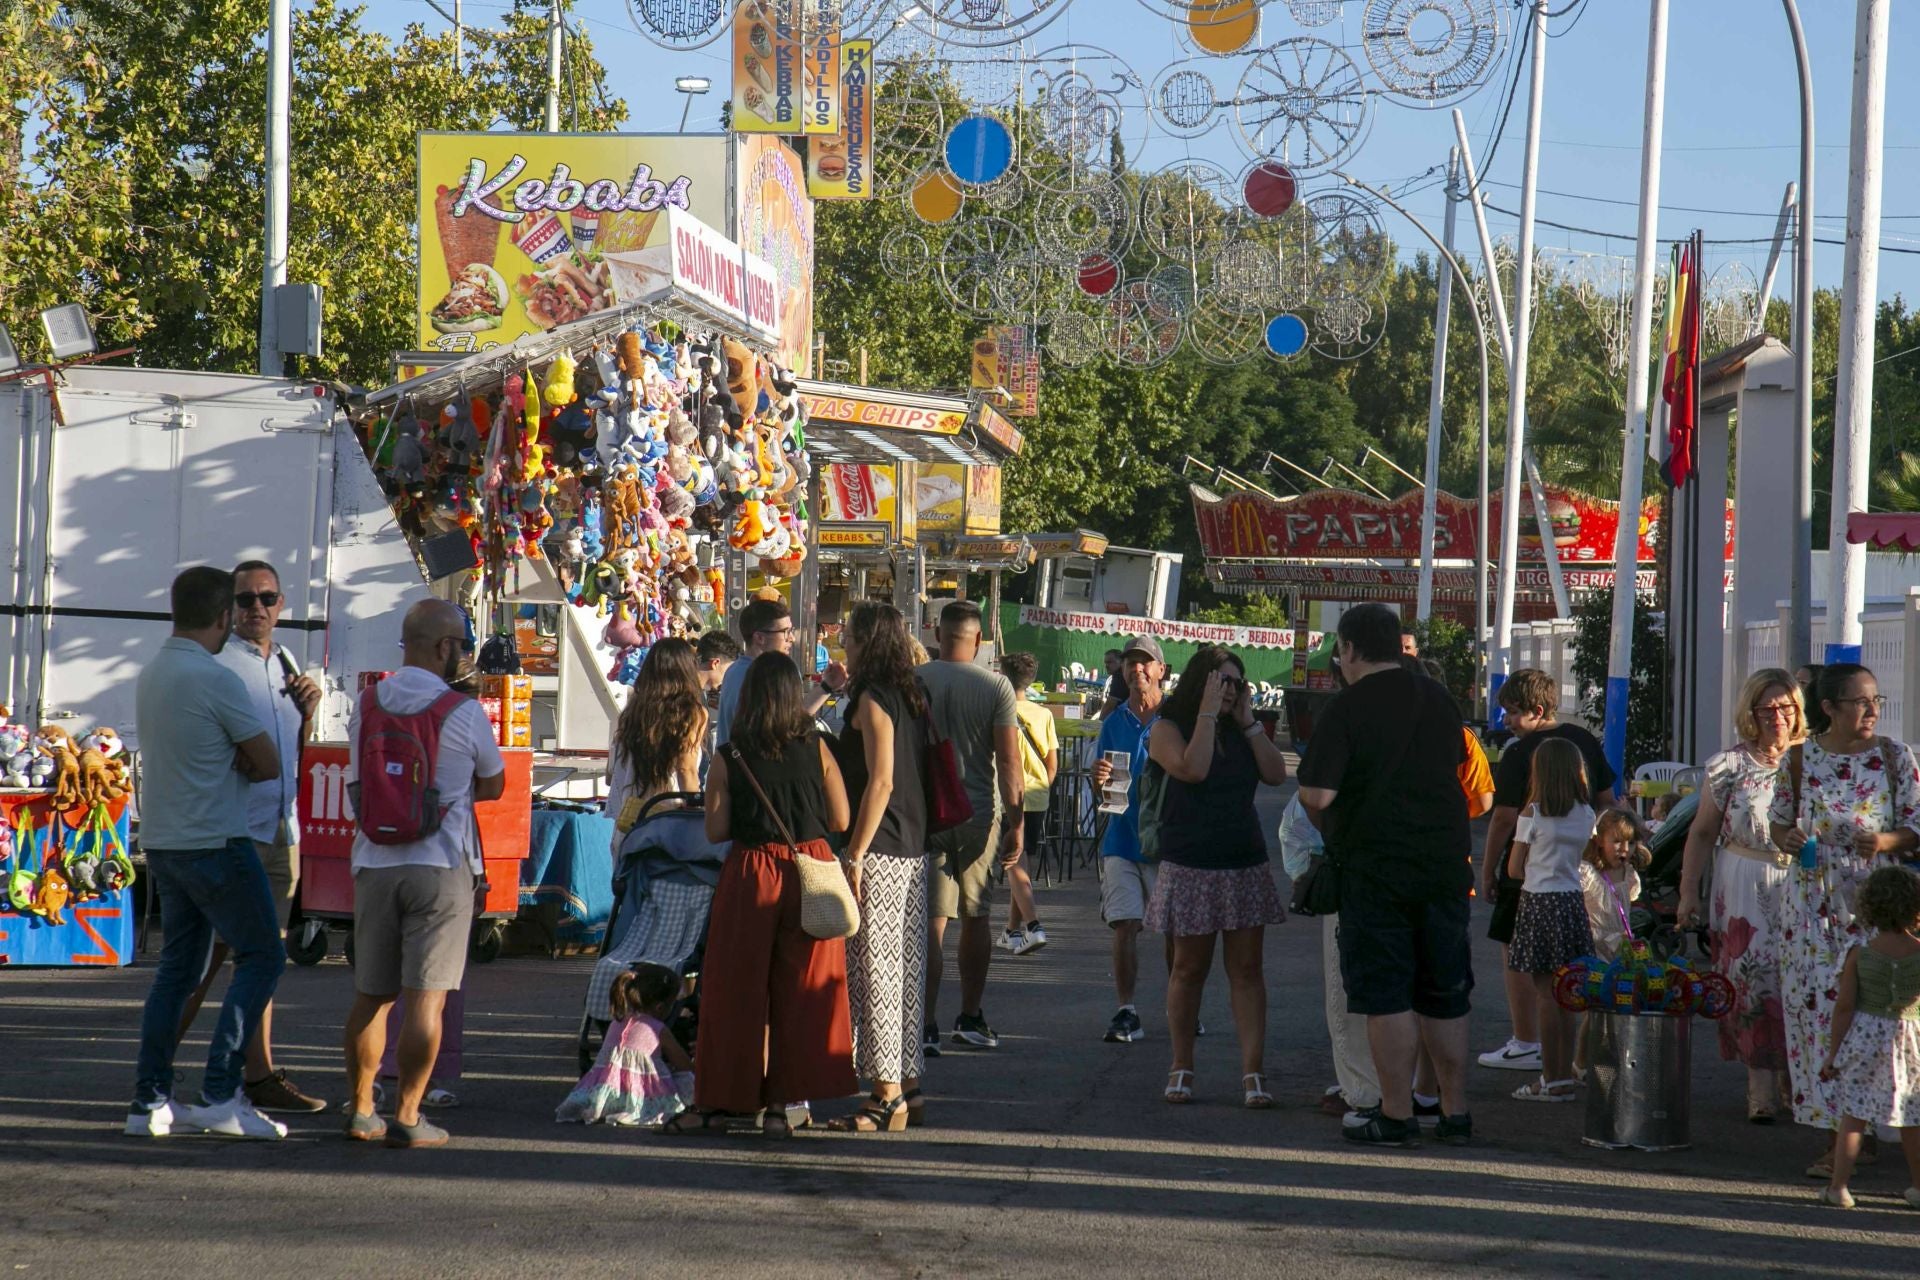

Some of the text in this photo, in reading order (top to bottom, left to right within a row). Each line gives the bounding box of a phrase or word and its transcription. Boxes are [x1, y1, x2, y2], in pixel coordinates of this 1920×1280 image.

[775, 45, 793, 123] KEBBAB
[845, 48, 866, 194] HAMBURGUESAS
[453, 153, 692, 224] Kebabs
[676, 226, 715, 296] SALÓN
[861, 403, 939, 430] CHIPS
[821, 533, 865, 542] KEBABS
[969, 542, 1019, 551] PATATAS
[1331, 568, 1383, 584] BOCADILLOS
[1026, 608, 1068, 626] PATATAS
[1069, 613, 1105, 629] FRITAS
[1117, 618, 1166, 635] PERRITOS
[1168, 624, 1182, 637] DE
[1183, 624, 1235, 642] BAGUETTE
[1248, 630, 1292, 646] BEBIDAS
